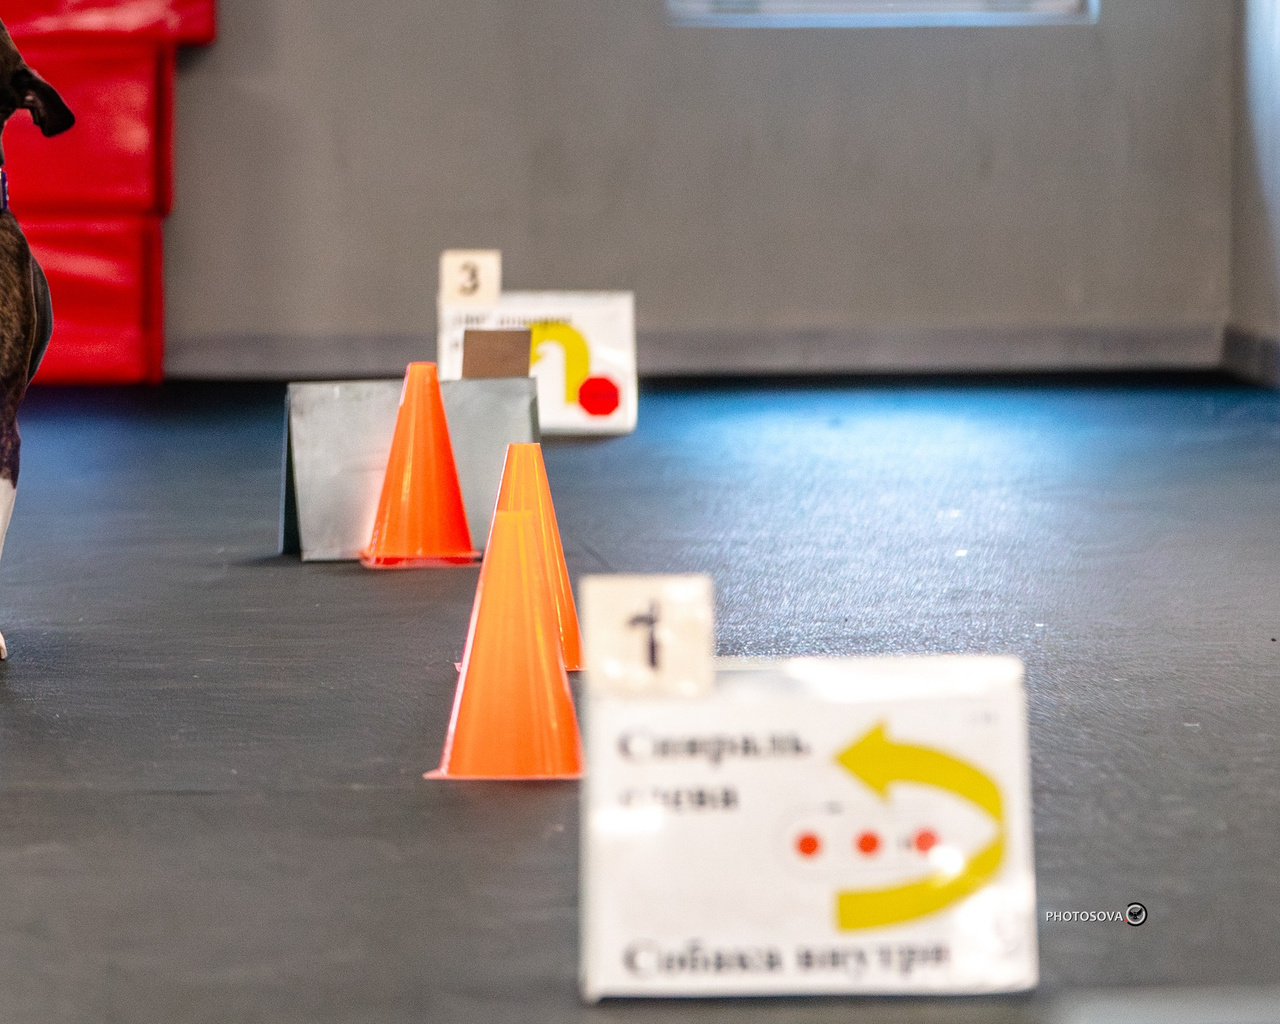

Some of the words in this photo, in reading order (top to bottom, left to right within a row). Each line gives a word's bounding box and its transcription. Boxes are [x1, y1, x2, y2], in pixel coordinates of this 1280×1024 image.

[458, 260, 480, 296] 3
[626, 596, 660, 671] 1
[622, 938, 784, 978] Собака
